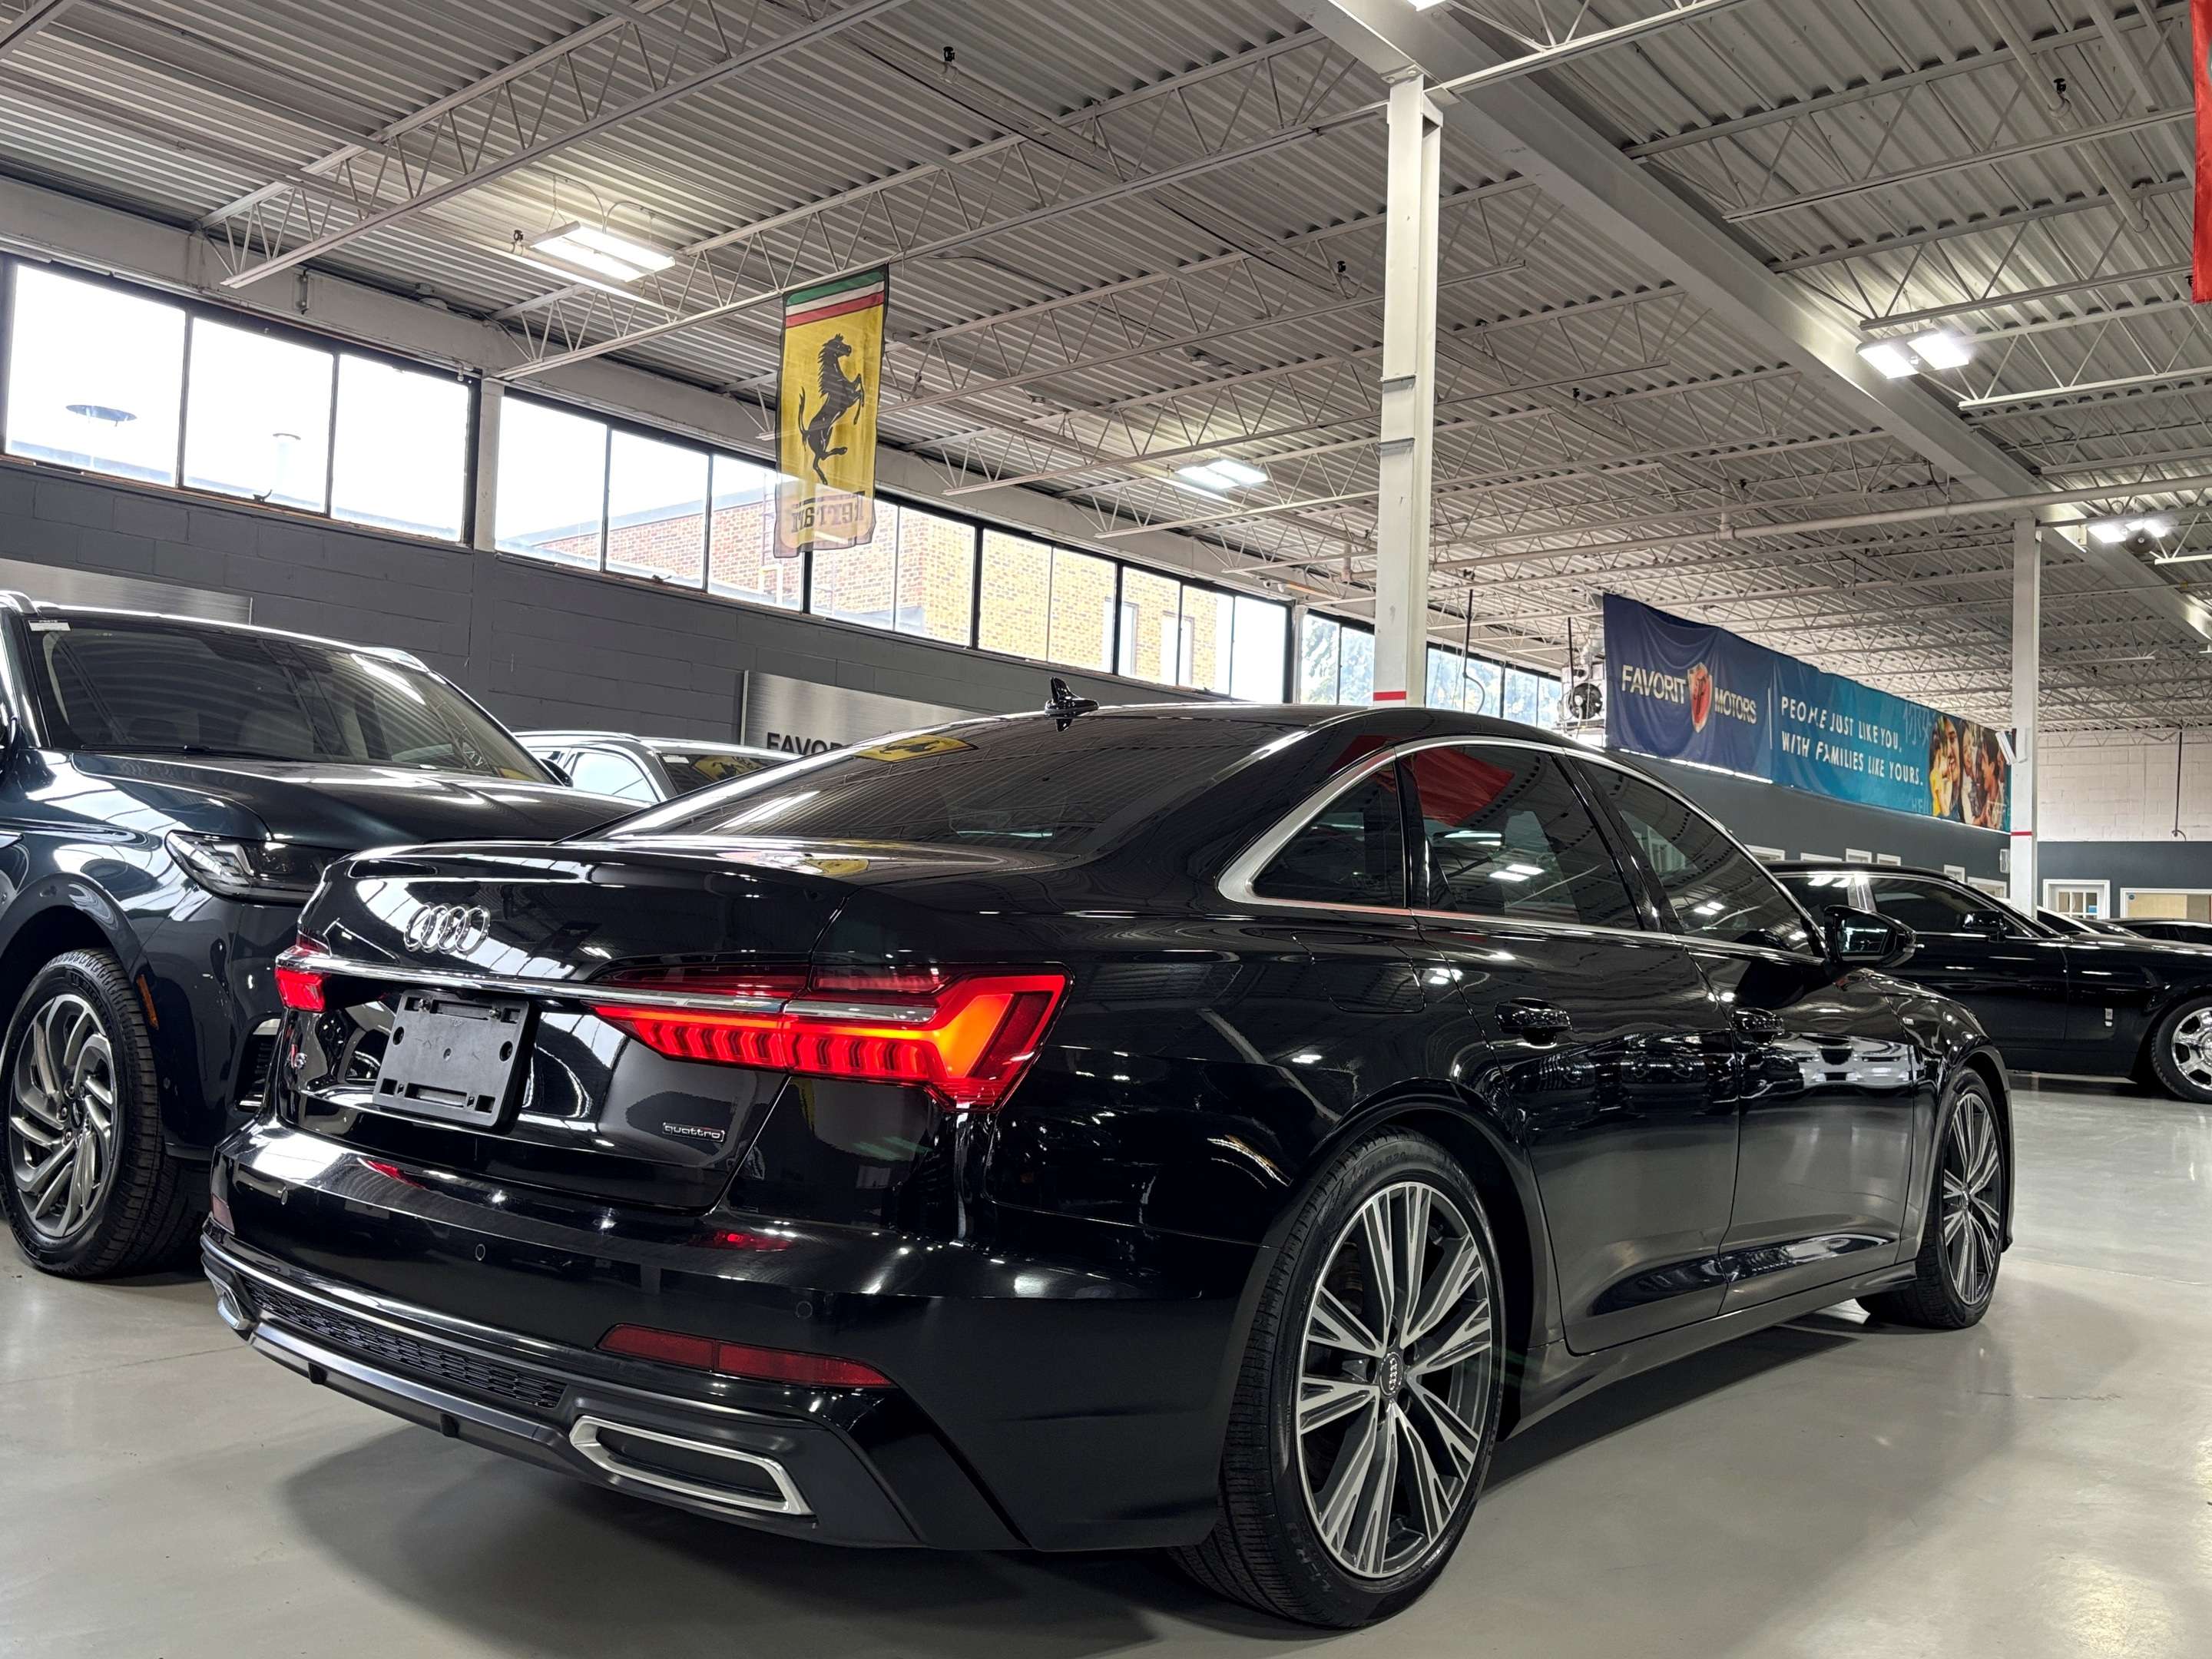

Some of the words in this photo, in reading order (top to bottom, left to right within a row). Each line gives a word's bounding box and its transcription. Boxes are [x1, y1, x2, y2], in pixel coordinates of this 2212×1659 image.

[1621, 664, 1687, 704] FAVORIT
[1714, 687, 1757, 724] MOTORS
[1830, 713, 1854, 737] JUST
[1859, 720, 1879, 744] LIKE
[1781, 731, 1810, 758] WITH
[1815, 741, 1864, 773] FAMILIES
[1868, 756, 1885, 778] LIKE
[1889, 761, 1924, 786] YOURS.
[664, 1125, 720, 1139] quattro
